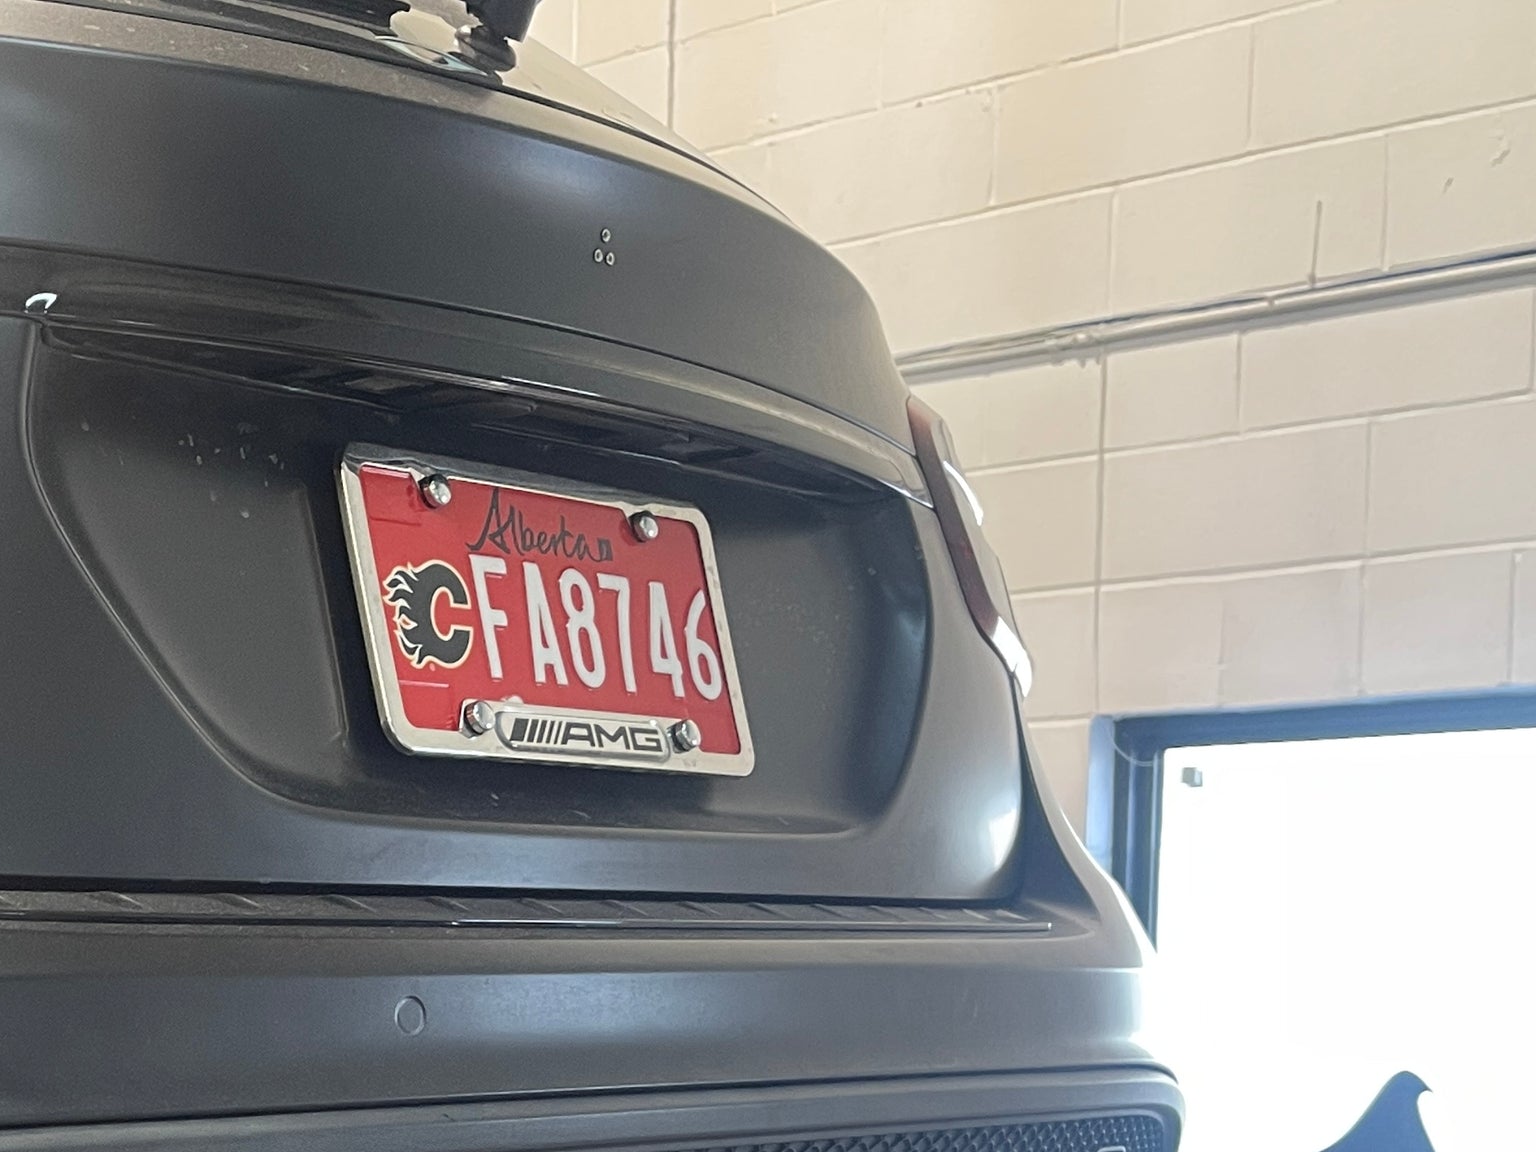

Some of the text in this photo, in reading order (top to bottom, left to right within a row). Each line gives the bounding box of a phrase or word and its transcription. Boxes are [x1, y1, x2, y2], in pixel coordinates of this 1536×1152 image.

[465, 486, 602, 562] Alberta
[469, 554, 722, 700] FA8746
[561, 721, 664, 753] AMG
